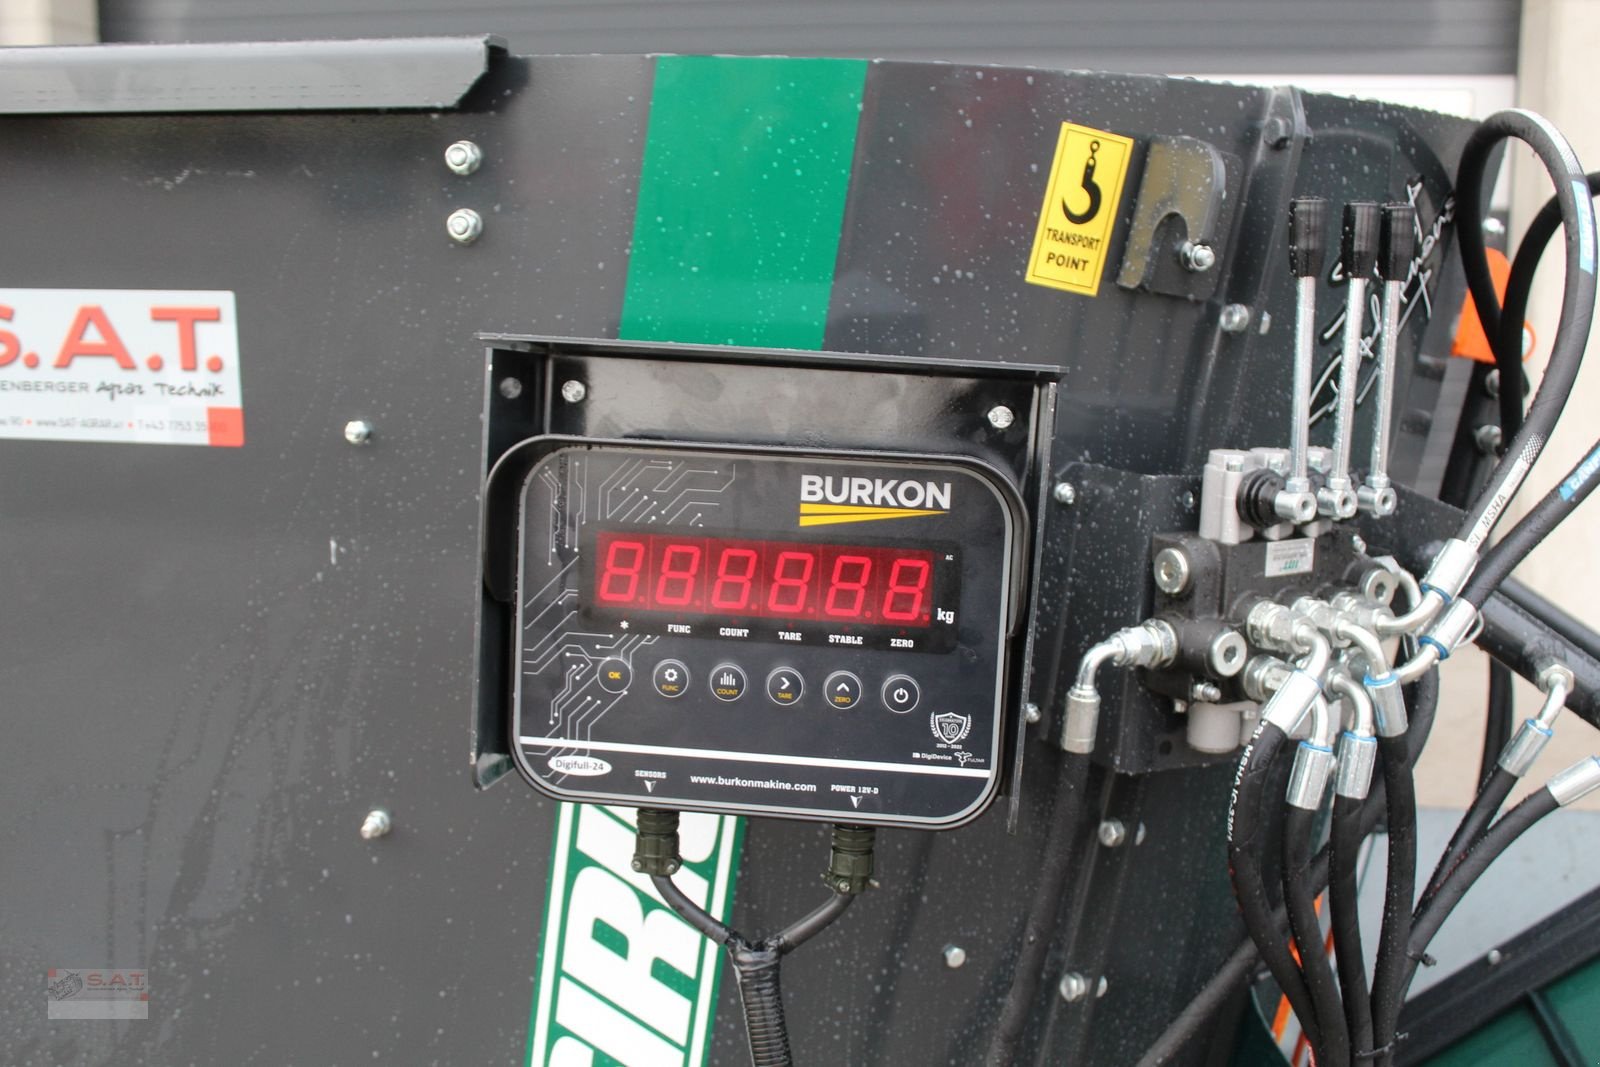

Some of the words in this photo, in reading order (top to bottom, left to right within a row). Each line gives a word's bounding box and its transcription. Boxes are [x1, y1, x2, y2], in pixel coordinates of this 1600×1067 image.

[1047, 228, 1101, 251] TRANSPORT
[1046, 252, 1089, 272] POINT
[153, 382, 224, 397] Technik
[800, 474, 953, 511] BURKON
[936, 607, 955, 625] kg
[667, 623, 691, 634] FUNC
[719, 627, 750, 638] COUNT
[778, 631, 802, 641] TARE
[828, 634, 864, 645] STABLE
[890, 638, 914, 649] ZERO
[608, 671, 621, 680] OK
[661, 683, 679, 692] FUNC
[716, 687, 739, 696] COUNT
[777, 691, 793, 700] TARE
[834, 695, 851, 704] ZERO
[942, 723, 960, 737] 10
[921, 752, 952, 760] DigiDevice
[555, 758, 605, 772] Digifull-24
[634, 769, 667, 780] SENSORS
[690, 774, 817, 793] www.burkonmakine.com
[830, 783, 856, 794] POWER
